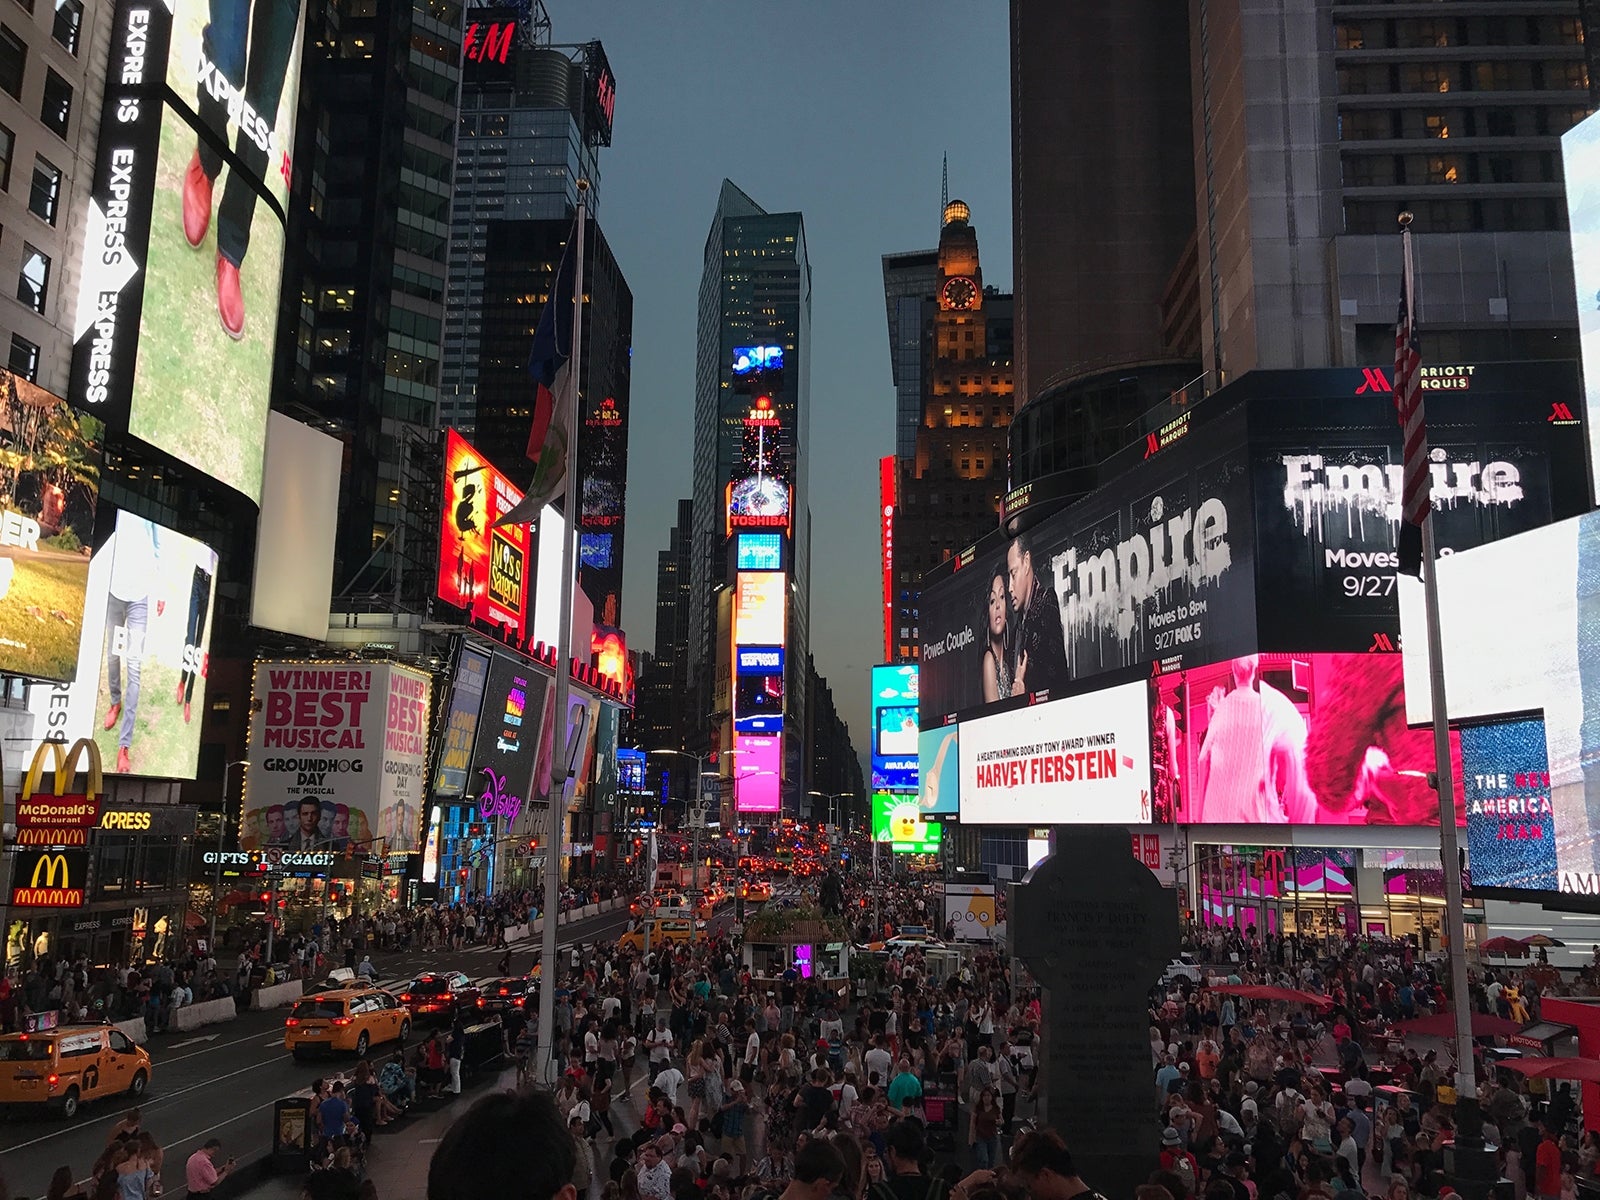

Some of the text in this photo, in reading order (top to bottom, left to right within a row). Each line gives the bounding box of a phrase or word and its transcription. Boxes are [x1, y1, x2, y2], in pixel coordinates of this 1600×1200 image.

[102, 149, 135, 265] EXPRESS
[86, 290, 117, 403] EXPRESS
[1421, 366, 1475, 377] RRIOTT
[1421, 378, 1468, 389] RQUIS
[1161, 411, 1191, 436] MARRIOTT
[1161, 425, 1188, 446] MARQUIS
[0, 509, 40, 553] ER
[731, 515, 788, 526] TOSHIBA
[1052, 496, 1232, 640] Empire
[492, 565, 520, 606] Saigon
[1343, 575, 1396, 597] 9/27
[1148, 610, 1176, 629] Moves
[1177, 605, 1188, 620] to
[1154, 622, 1201, 651] 9/27 FOX 5
[1162, 654, 1183, 664] MARRIOTT
[269, 670, 372, 691] WINNER!
[265, 692, 369, 727] BEST
[386, 692, 425, 733] BEST
[263, 728, 365, 749] MUSICAL
[386, 730, 423, 755] MUSICAL
[977, 752, 981, 762] A
[981, 747, 1020, 761] HEARTWARMING
[1020, 744, 1035, 756] BOOK
[1036, 743, 1043, 754] BY
[1044, 740, 1060, 752] TONY
[1086, 732, 1116, 747] WINNER
[263, 757, 363, 773] GROUNDHOG
[884, 760, 919, 770] AVAILABL
[977, 748, 1117, 788] HARVEY FIERSTEIN
[296, 772, 325, 786] DAY
[396, 776, 409, 790] DAY
[1475, 773, 1508, 789] THE
[287, 786, 335, 795] THE MUSICAL
[479, 767, 521, 833] Disney
[19, 804, 95, 816] McDonald's
[1472, 797, 1553, 814] AMERICA
[30, 816, 81, 824] Restaurant
[101, 811, 151, 830] XPRESS
[74, 920, 101, 931] EXPRESS
